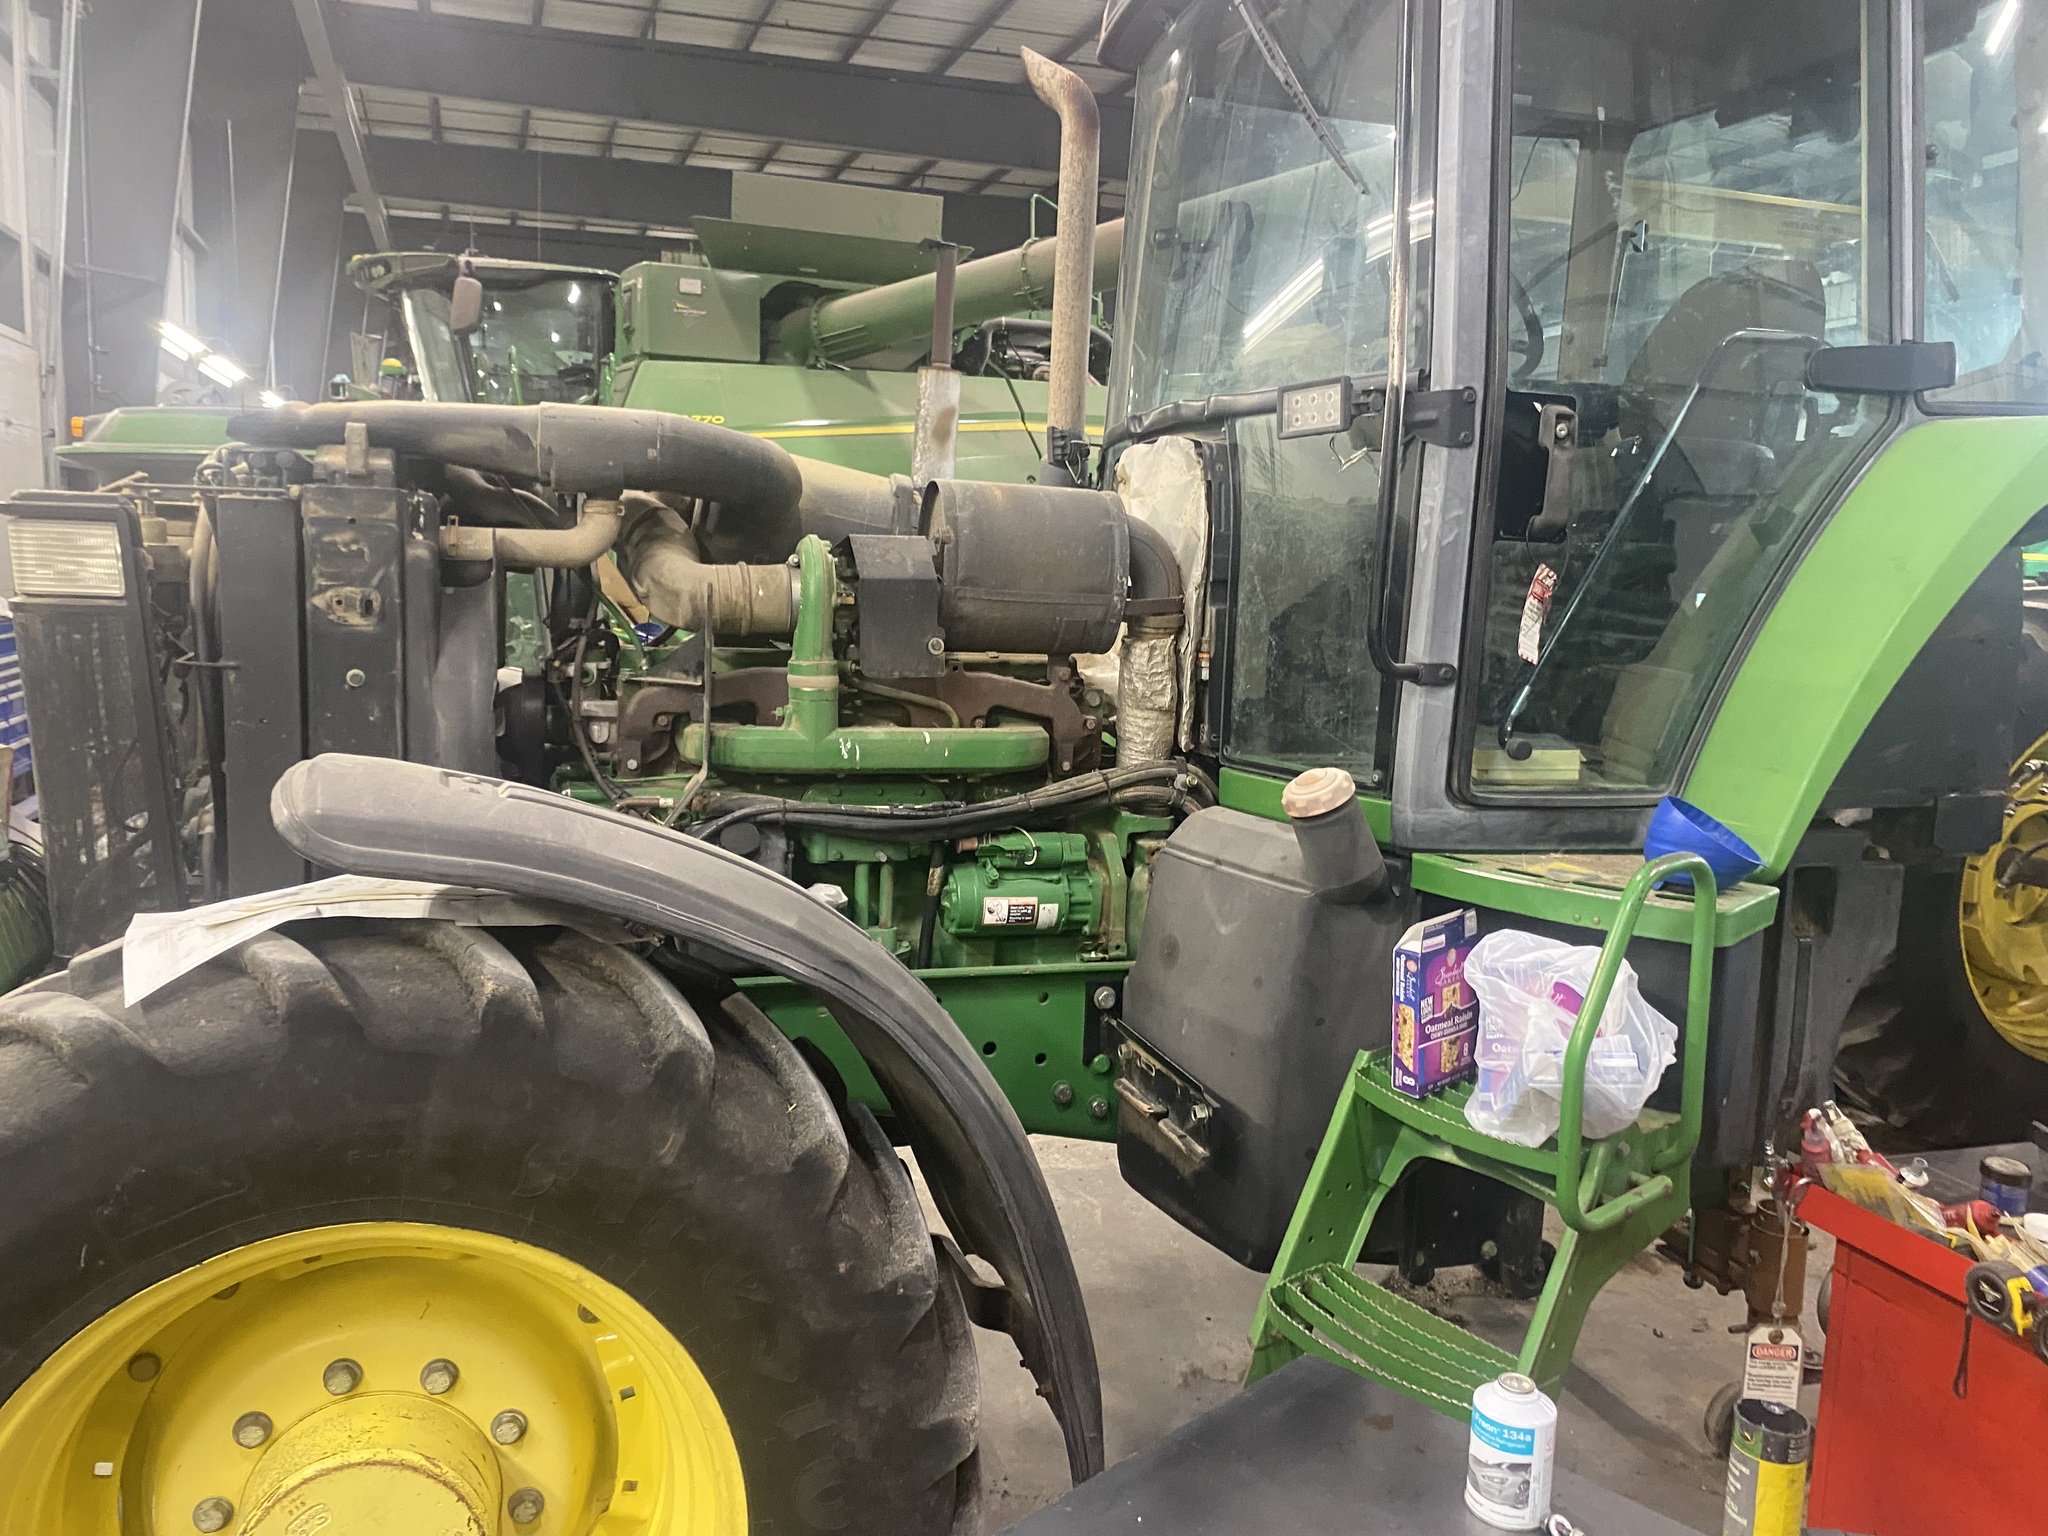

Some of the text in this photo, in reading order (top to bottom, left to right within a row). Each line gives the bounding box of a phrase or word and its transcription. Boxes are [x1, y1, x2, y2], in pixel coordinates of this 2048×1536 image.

[1425, 1017, 1454, 1035] Oatmeal
[1454, 1011, 1473, 1025] Raisin
[1463, 1042, 1469, 1057] 8
[1403, 1075, 1416, 1086] 8
[1755, 1346, 1793, 1358] DANGER
[1502, 1428, 1532, 1442] 134a
